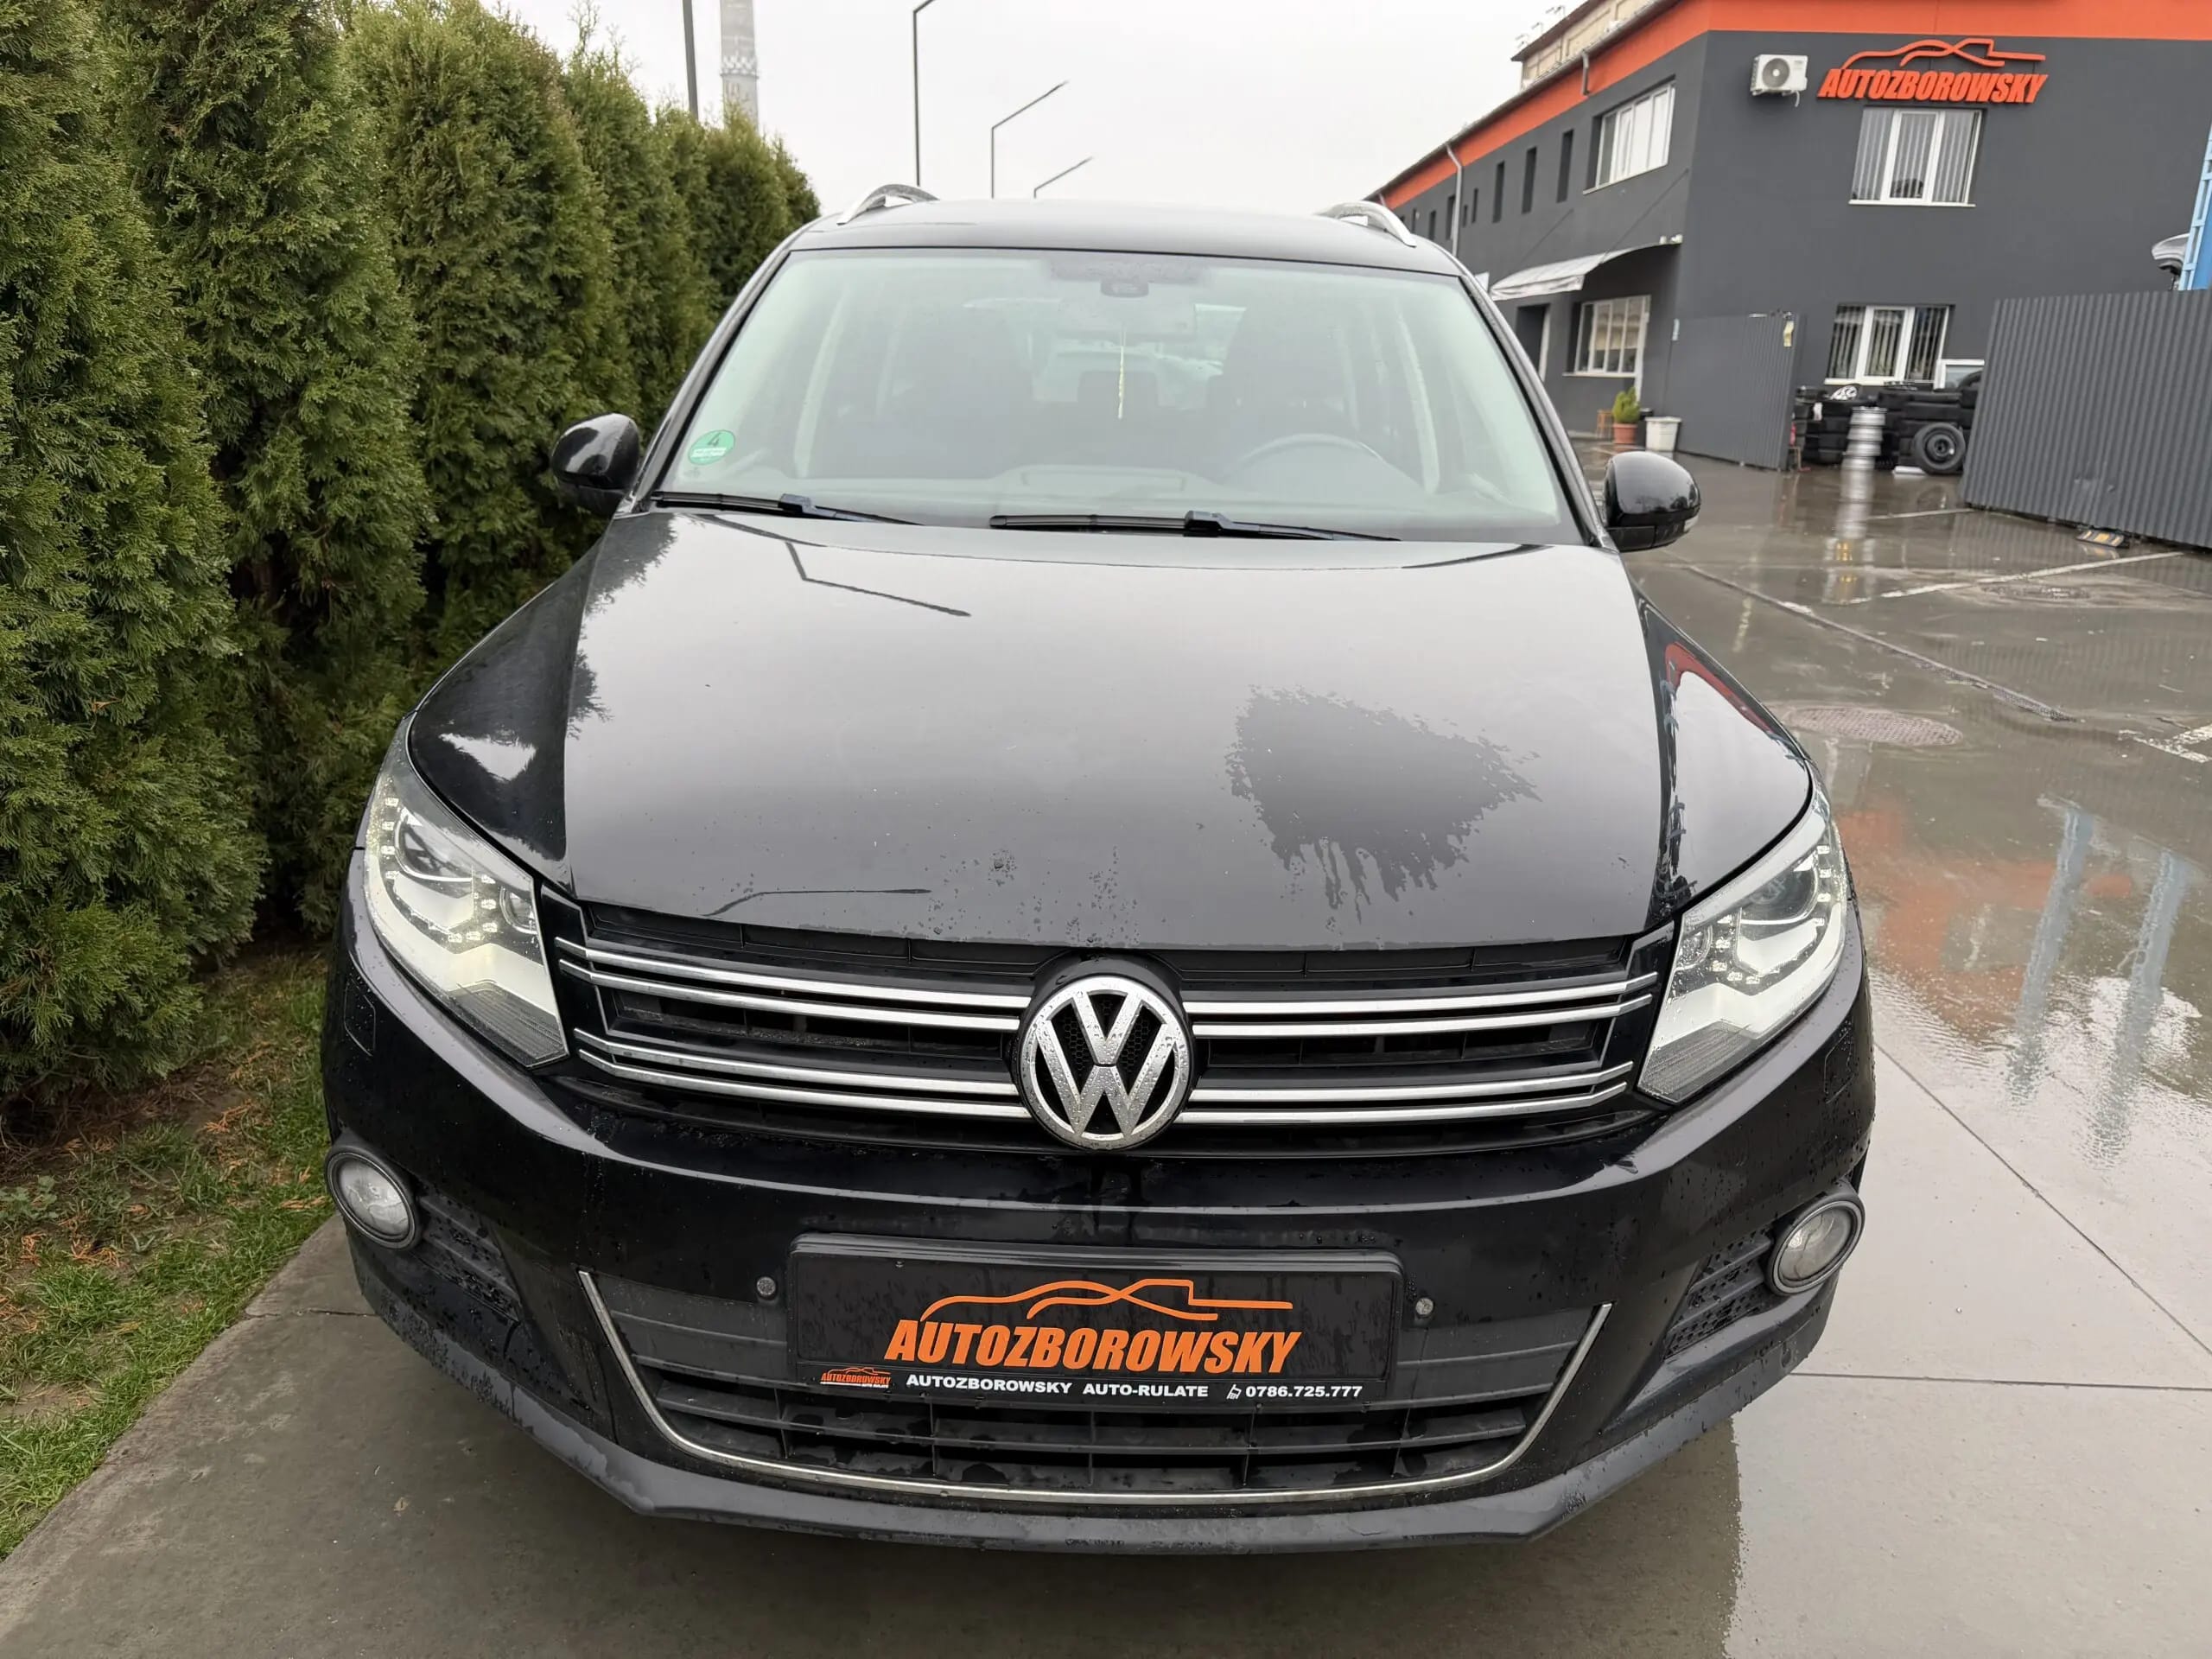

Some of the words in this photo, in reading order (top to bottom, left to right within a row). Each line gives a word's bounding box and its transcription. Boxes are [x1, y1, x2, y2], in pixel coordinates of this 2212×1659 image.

[1817, 68, 2048, 103] AUTOZBOROWSKY
[884, 1319, 1301, 1373] AUTOZBOROWSKY
[906, 1374, 1072, 1393] AUTOZBOROWSKY
[1083, 1383, 1209, 1397] AUTO-RULATE
[1245, 1385, 1363, 1398] 0786.725.777
